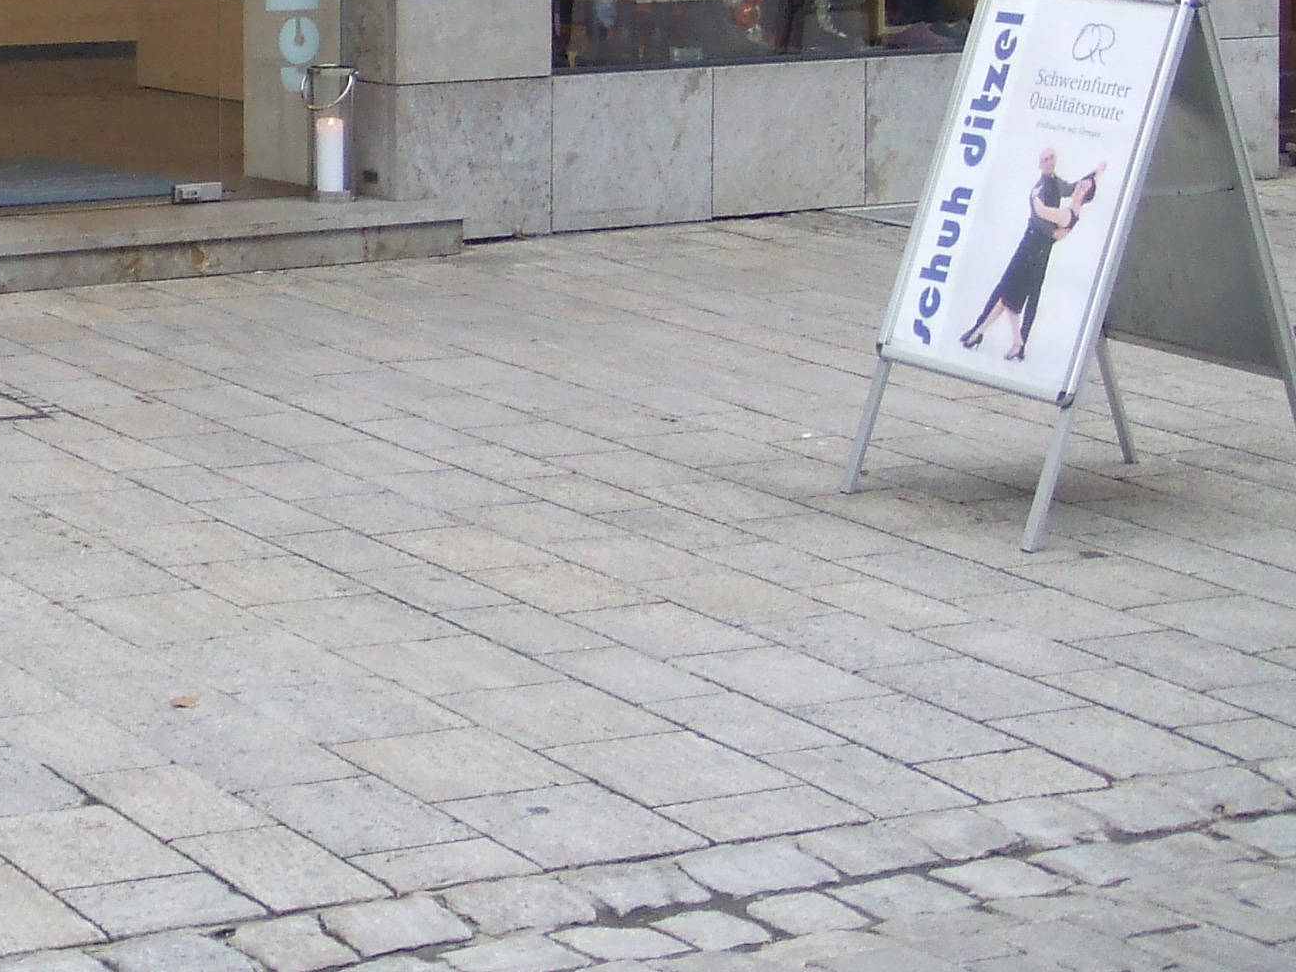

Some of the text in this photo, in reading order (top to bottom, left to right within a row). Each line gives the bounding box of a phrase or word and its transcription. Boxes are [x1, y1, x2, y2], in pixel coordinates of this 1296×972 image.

[1035, 68, 1133, 98] Schweinfurter
[1029, 91, 1124, 121] Qualitätsroute
[912, 11, 1025, 345] schuh ditzel
